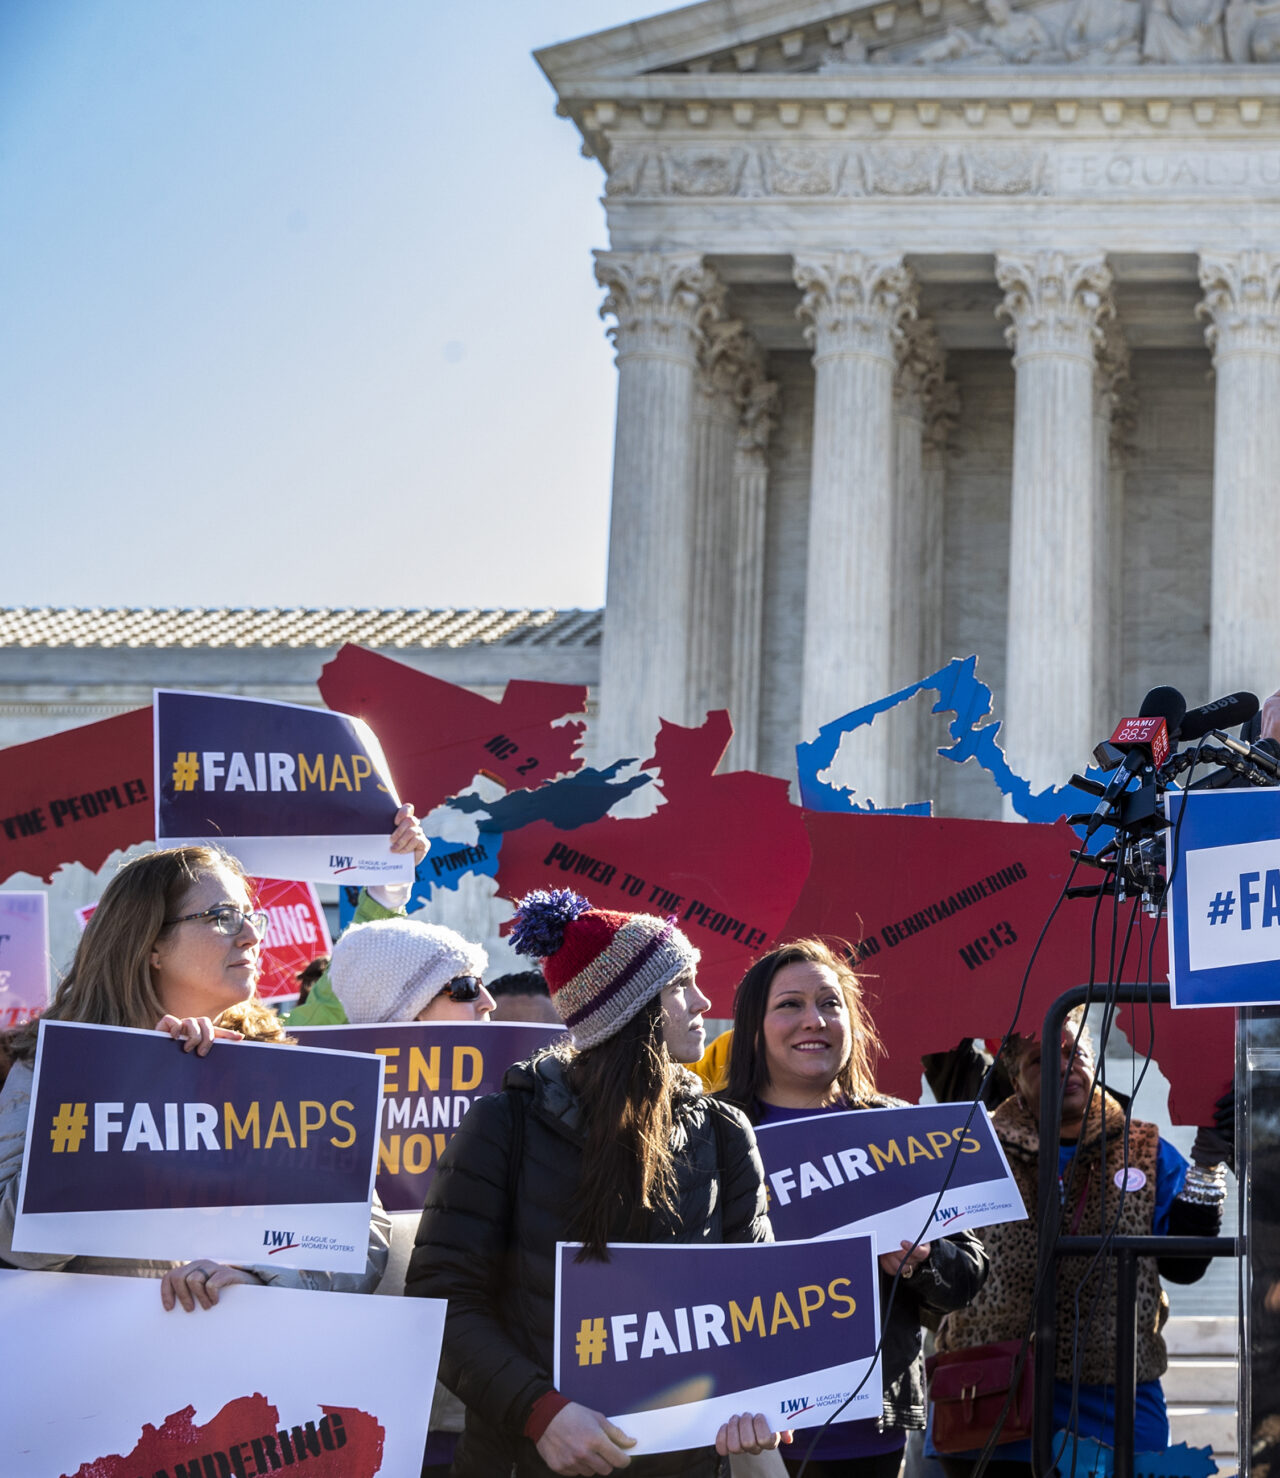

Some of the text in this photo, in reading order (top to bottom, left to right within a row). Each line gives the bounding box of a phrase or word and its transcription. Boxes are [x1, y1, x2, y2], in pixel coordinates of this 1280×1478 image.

[1081, 154, 1221, 187] EQUAL
[1126, 719, 1156, 728] WAMU
[1118, 727, 1151, 741] 88.5
[484, 734, 539, 776] NC 2
[0, 778, 149, 841] THE PEOPLE!
[329, 855, 353, 869] LWV
[431, 844, 489, 878] POWER
[543, 841, 768, 951] POWER TO THE PEOPLE!
[880, 861, 1028, 949] GERRYMANDERING
[375, 1045, 484, 1093] END
[50, 1099, 357, 1153] #FAIRMAPS
[934, 1206, 958, 1222] LWV
[262, 1229, 295, 1247] LWV
[301, 1235, 328, 1243] LEAGUE
[301, 1242, 355, 1252] WOMEN VOTERS
[575, 1277, 857, 1367] #FAIRMAPS
[780, 1396, 809, 1414] LWV
[816, 1392, 842, 1402] LEAGUE
[816, 1399, 843, 1408] WOMEN
